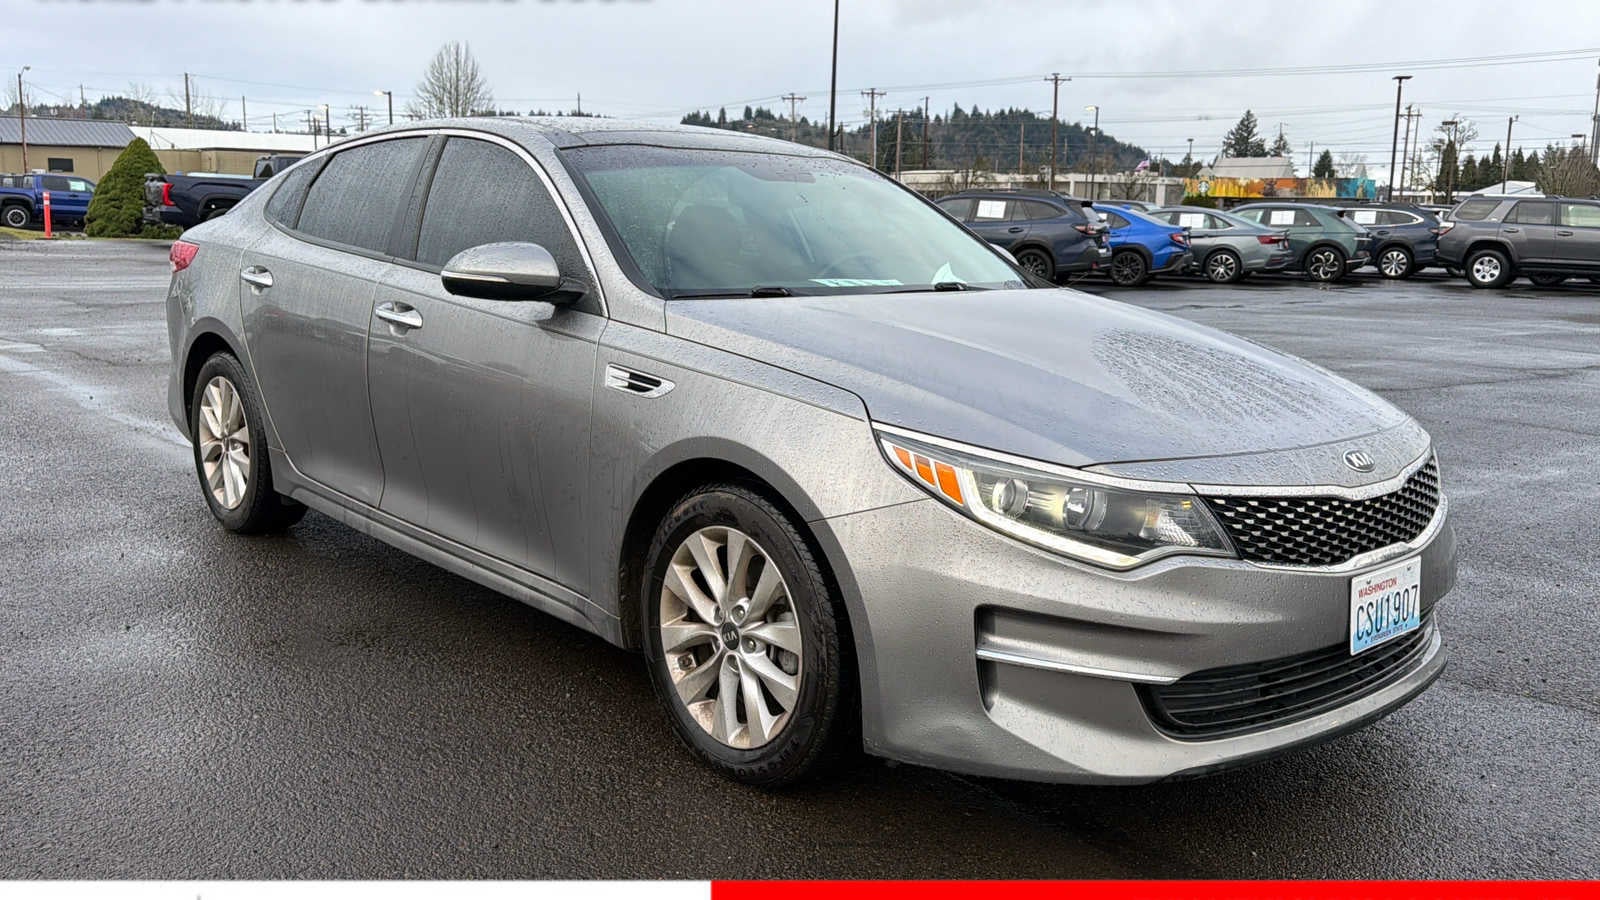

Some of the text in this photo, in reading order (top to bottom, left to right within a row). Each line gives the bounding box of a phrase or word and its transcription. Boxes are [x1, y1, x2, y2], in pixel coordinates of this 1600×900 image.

[1347, 452, 1374, 466] KIA
[1358, 578, 1397, 598] WASHINGTON
[1357, 585, 1418, 641] CSU1907
